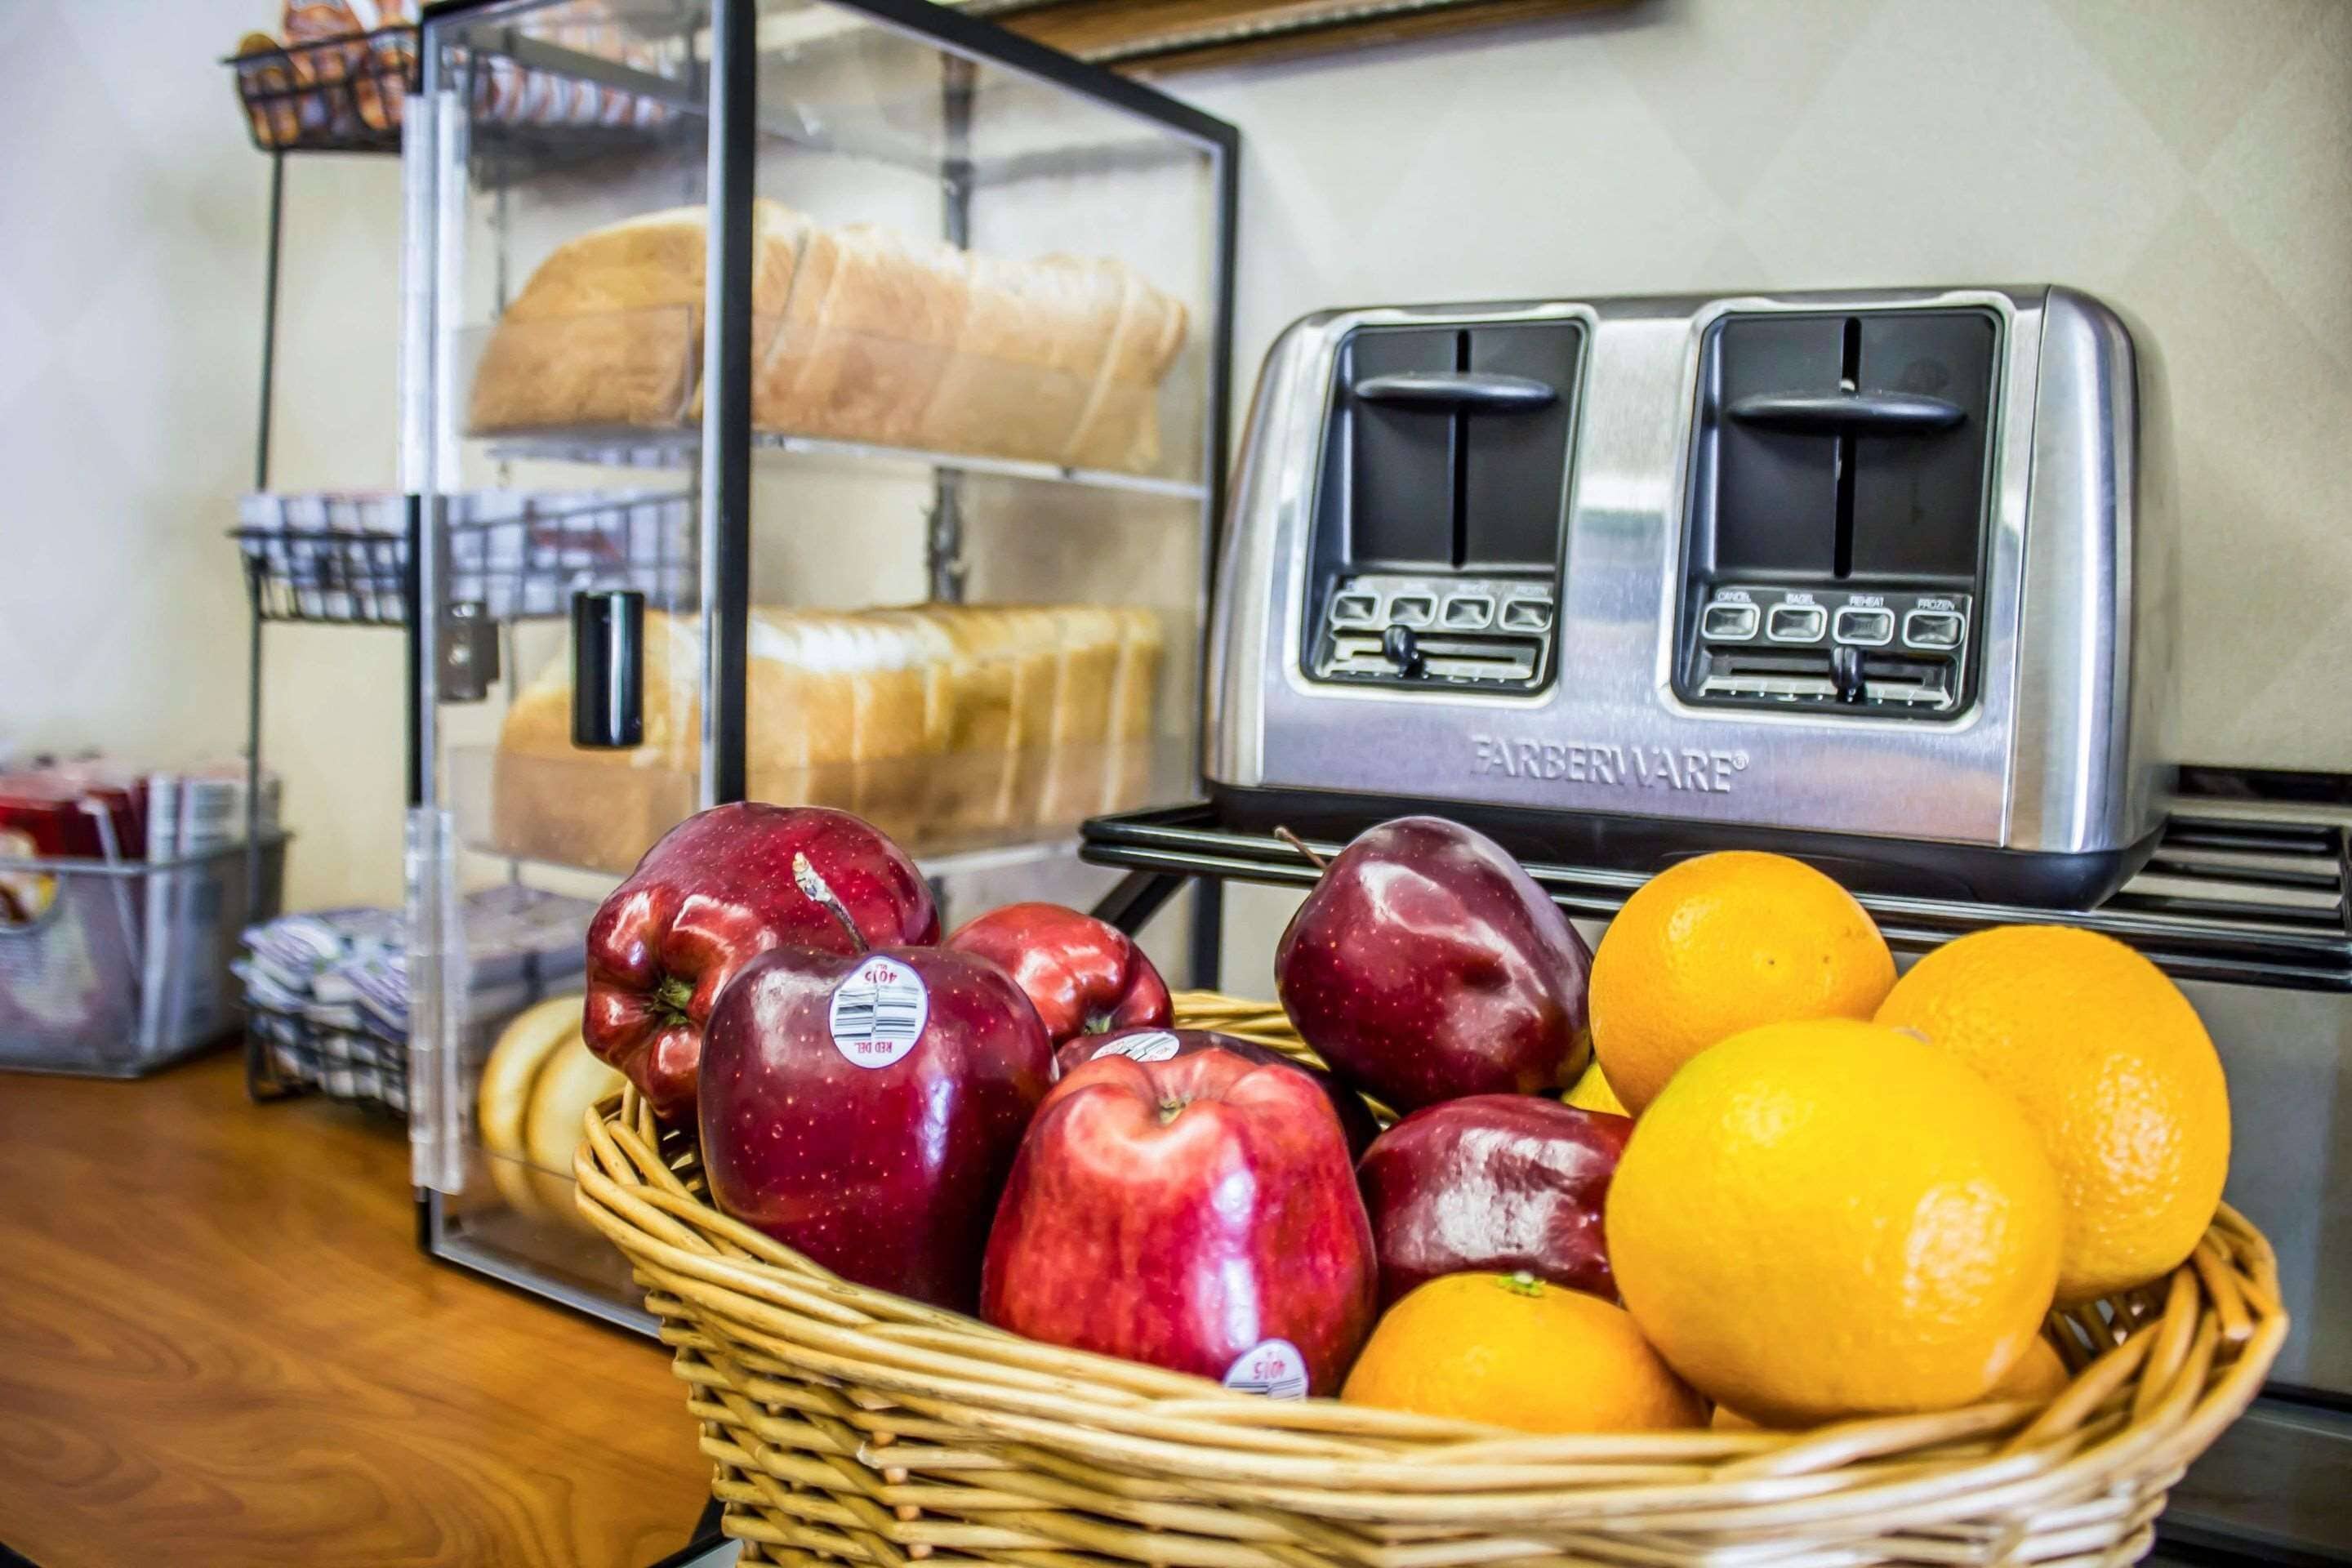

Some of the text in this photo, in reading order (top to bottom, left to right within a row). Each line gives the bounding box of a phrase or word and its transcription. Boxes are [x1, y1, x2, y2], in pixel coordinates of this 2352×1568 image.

[1717, 592, 1752, 603] CANCEL
[1786, 594, 1815, 604] BAGEL
[1850, 595, 1884, 607] REHEAT
[1918, 599, 1955, 610] FROZEN
[875, 1041, 893, 1054] RED
